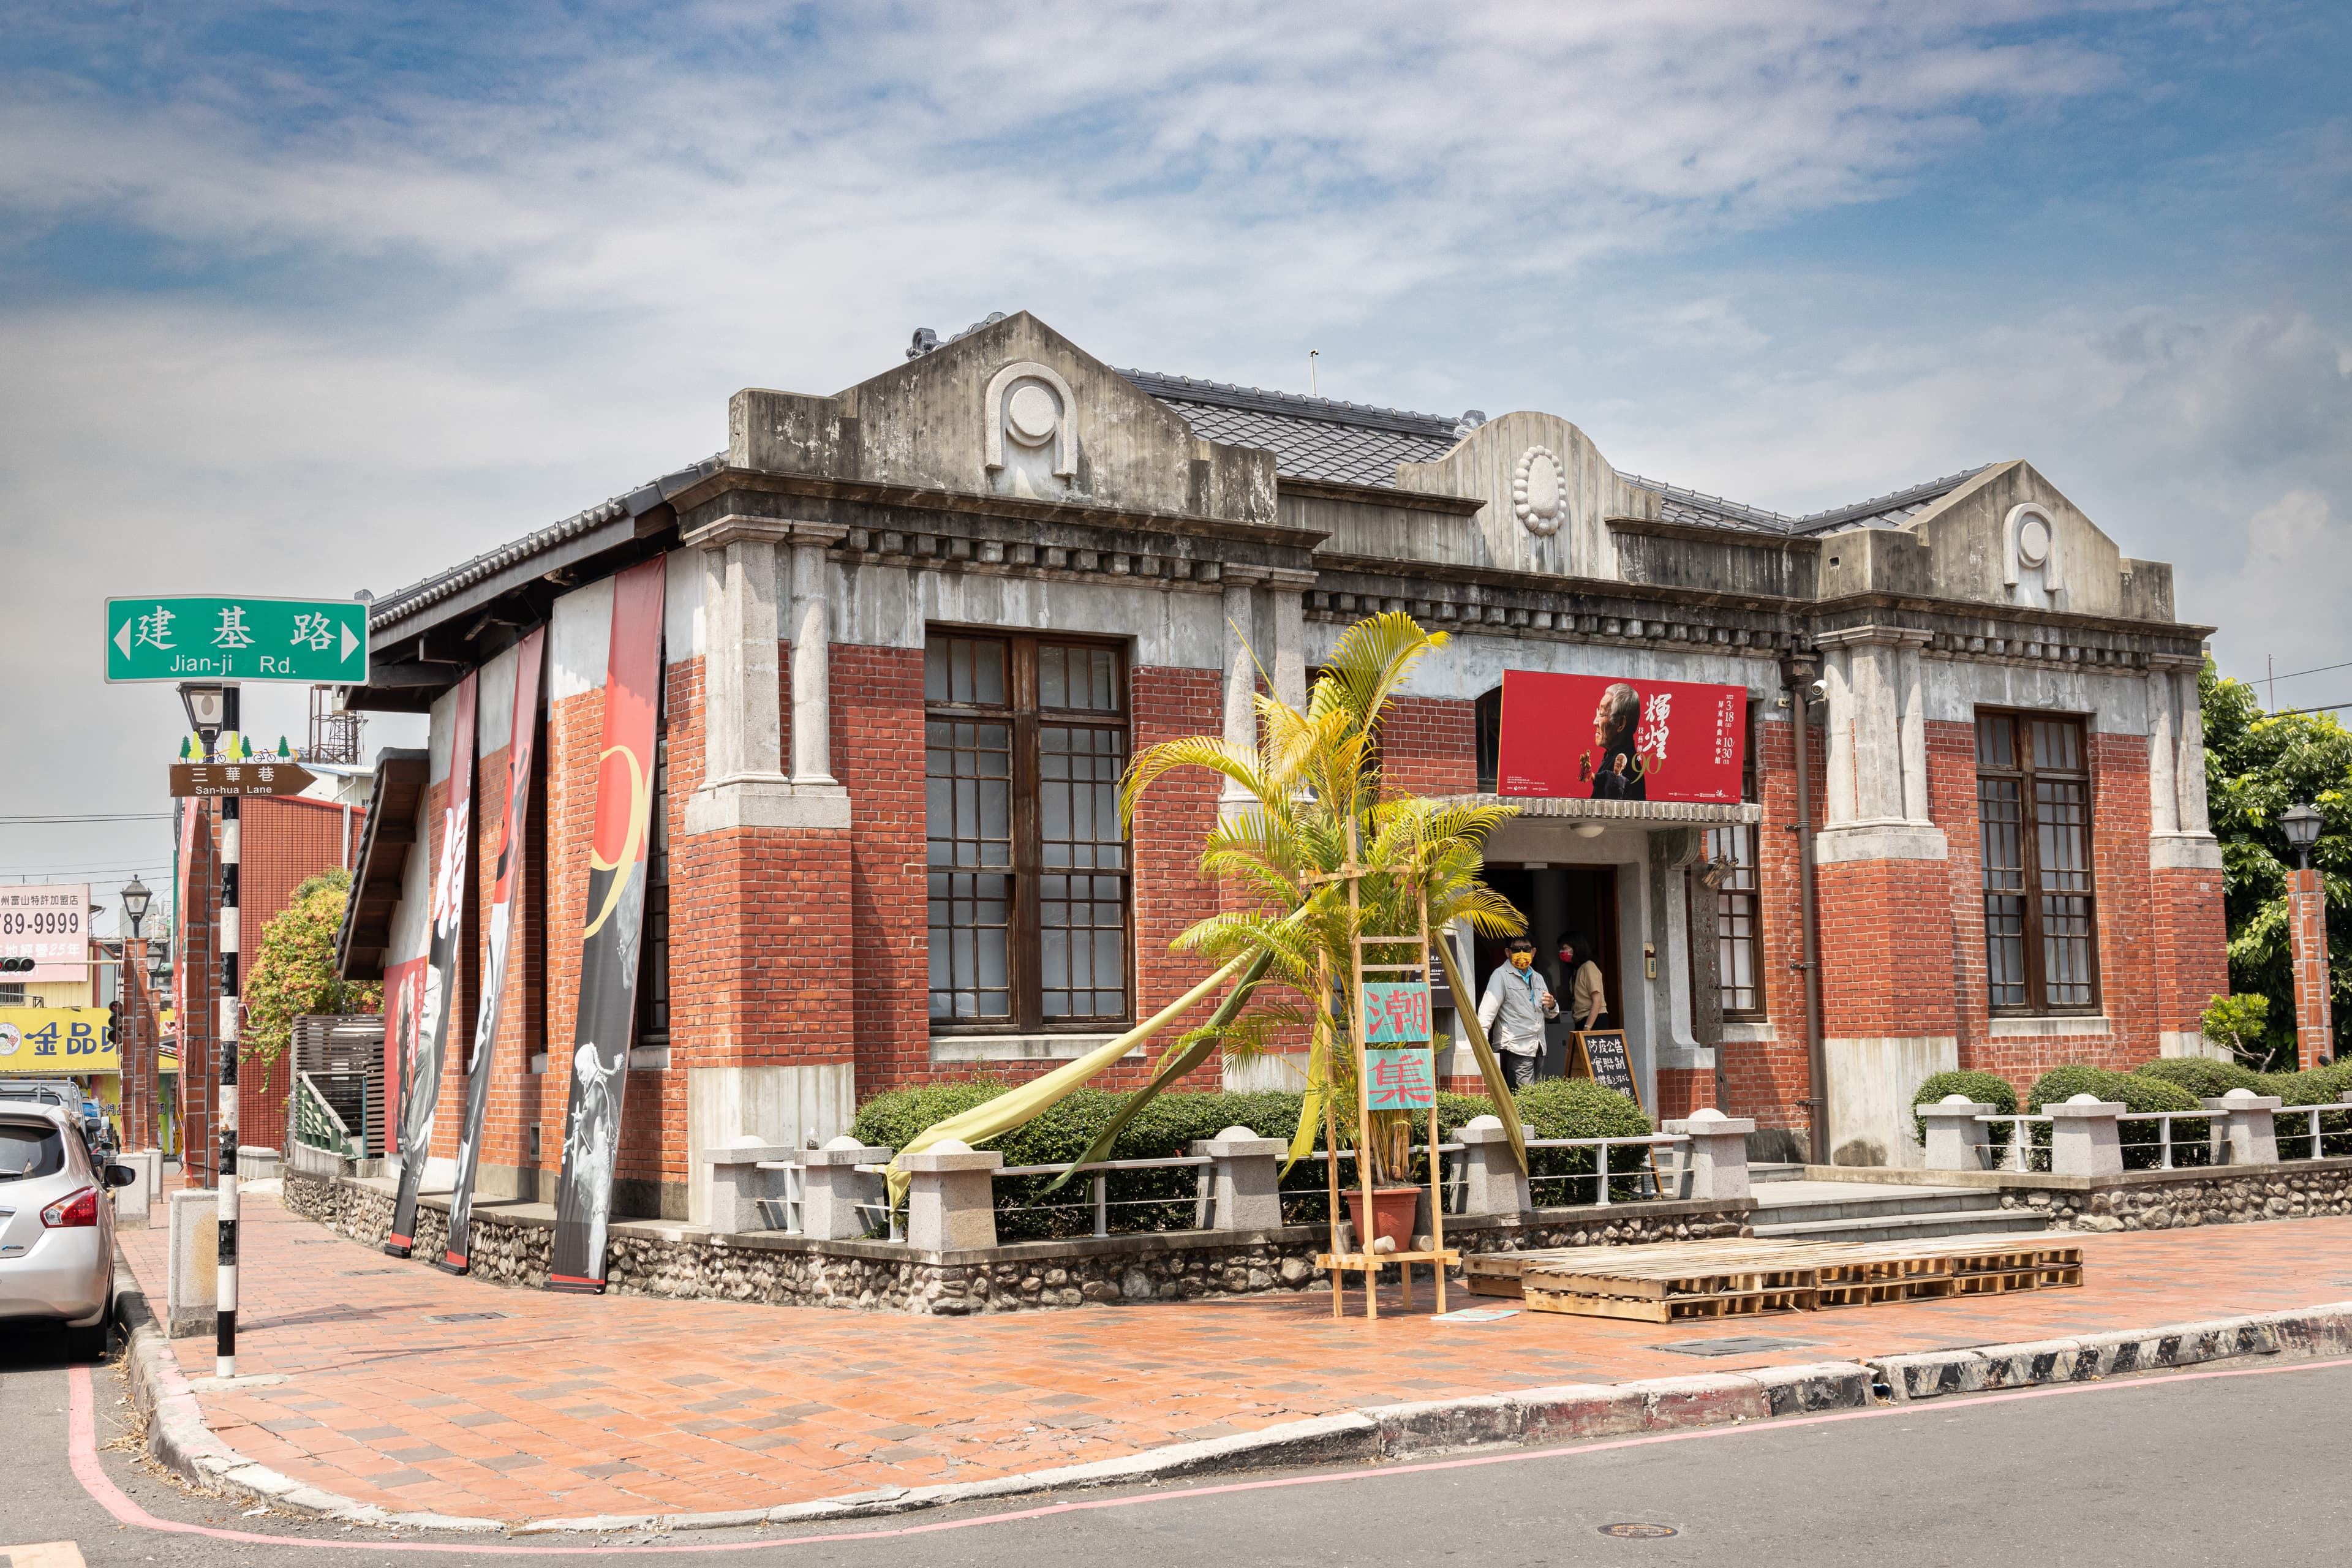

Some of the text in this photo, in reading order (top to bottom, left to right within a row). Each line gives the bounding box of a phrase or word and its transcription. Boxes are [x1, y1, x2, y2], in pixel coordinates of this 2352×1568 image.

[135, 605, 337, 652] 建基路
[170, 654, 297, 675] Jian-ji Rd.
[1643, 693, 1672, 760] 輝煌
[191, 767, 274, 782] 三華巷
[195, 785, 273, 795] San-hua Lane
[0, 912, 79, 935] 89-9999
[1366, 989, 1428, 1035] 潮
[1587, 1038, 1624, 1054] 防疫公告
[1368, 1054, 1432, 1104] 集
